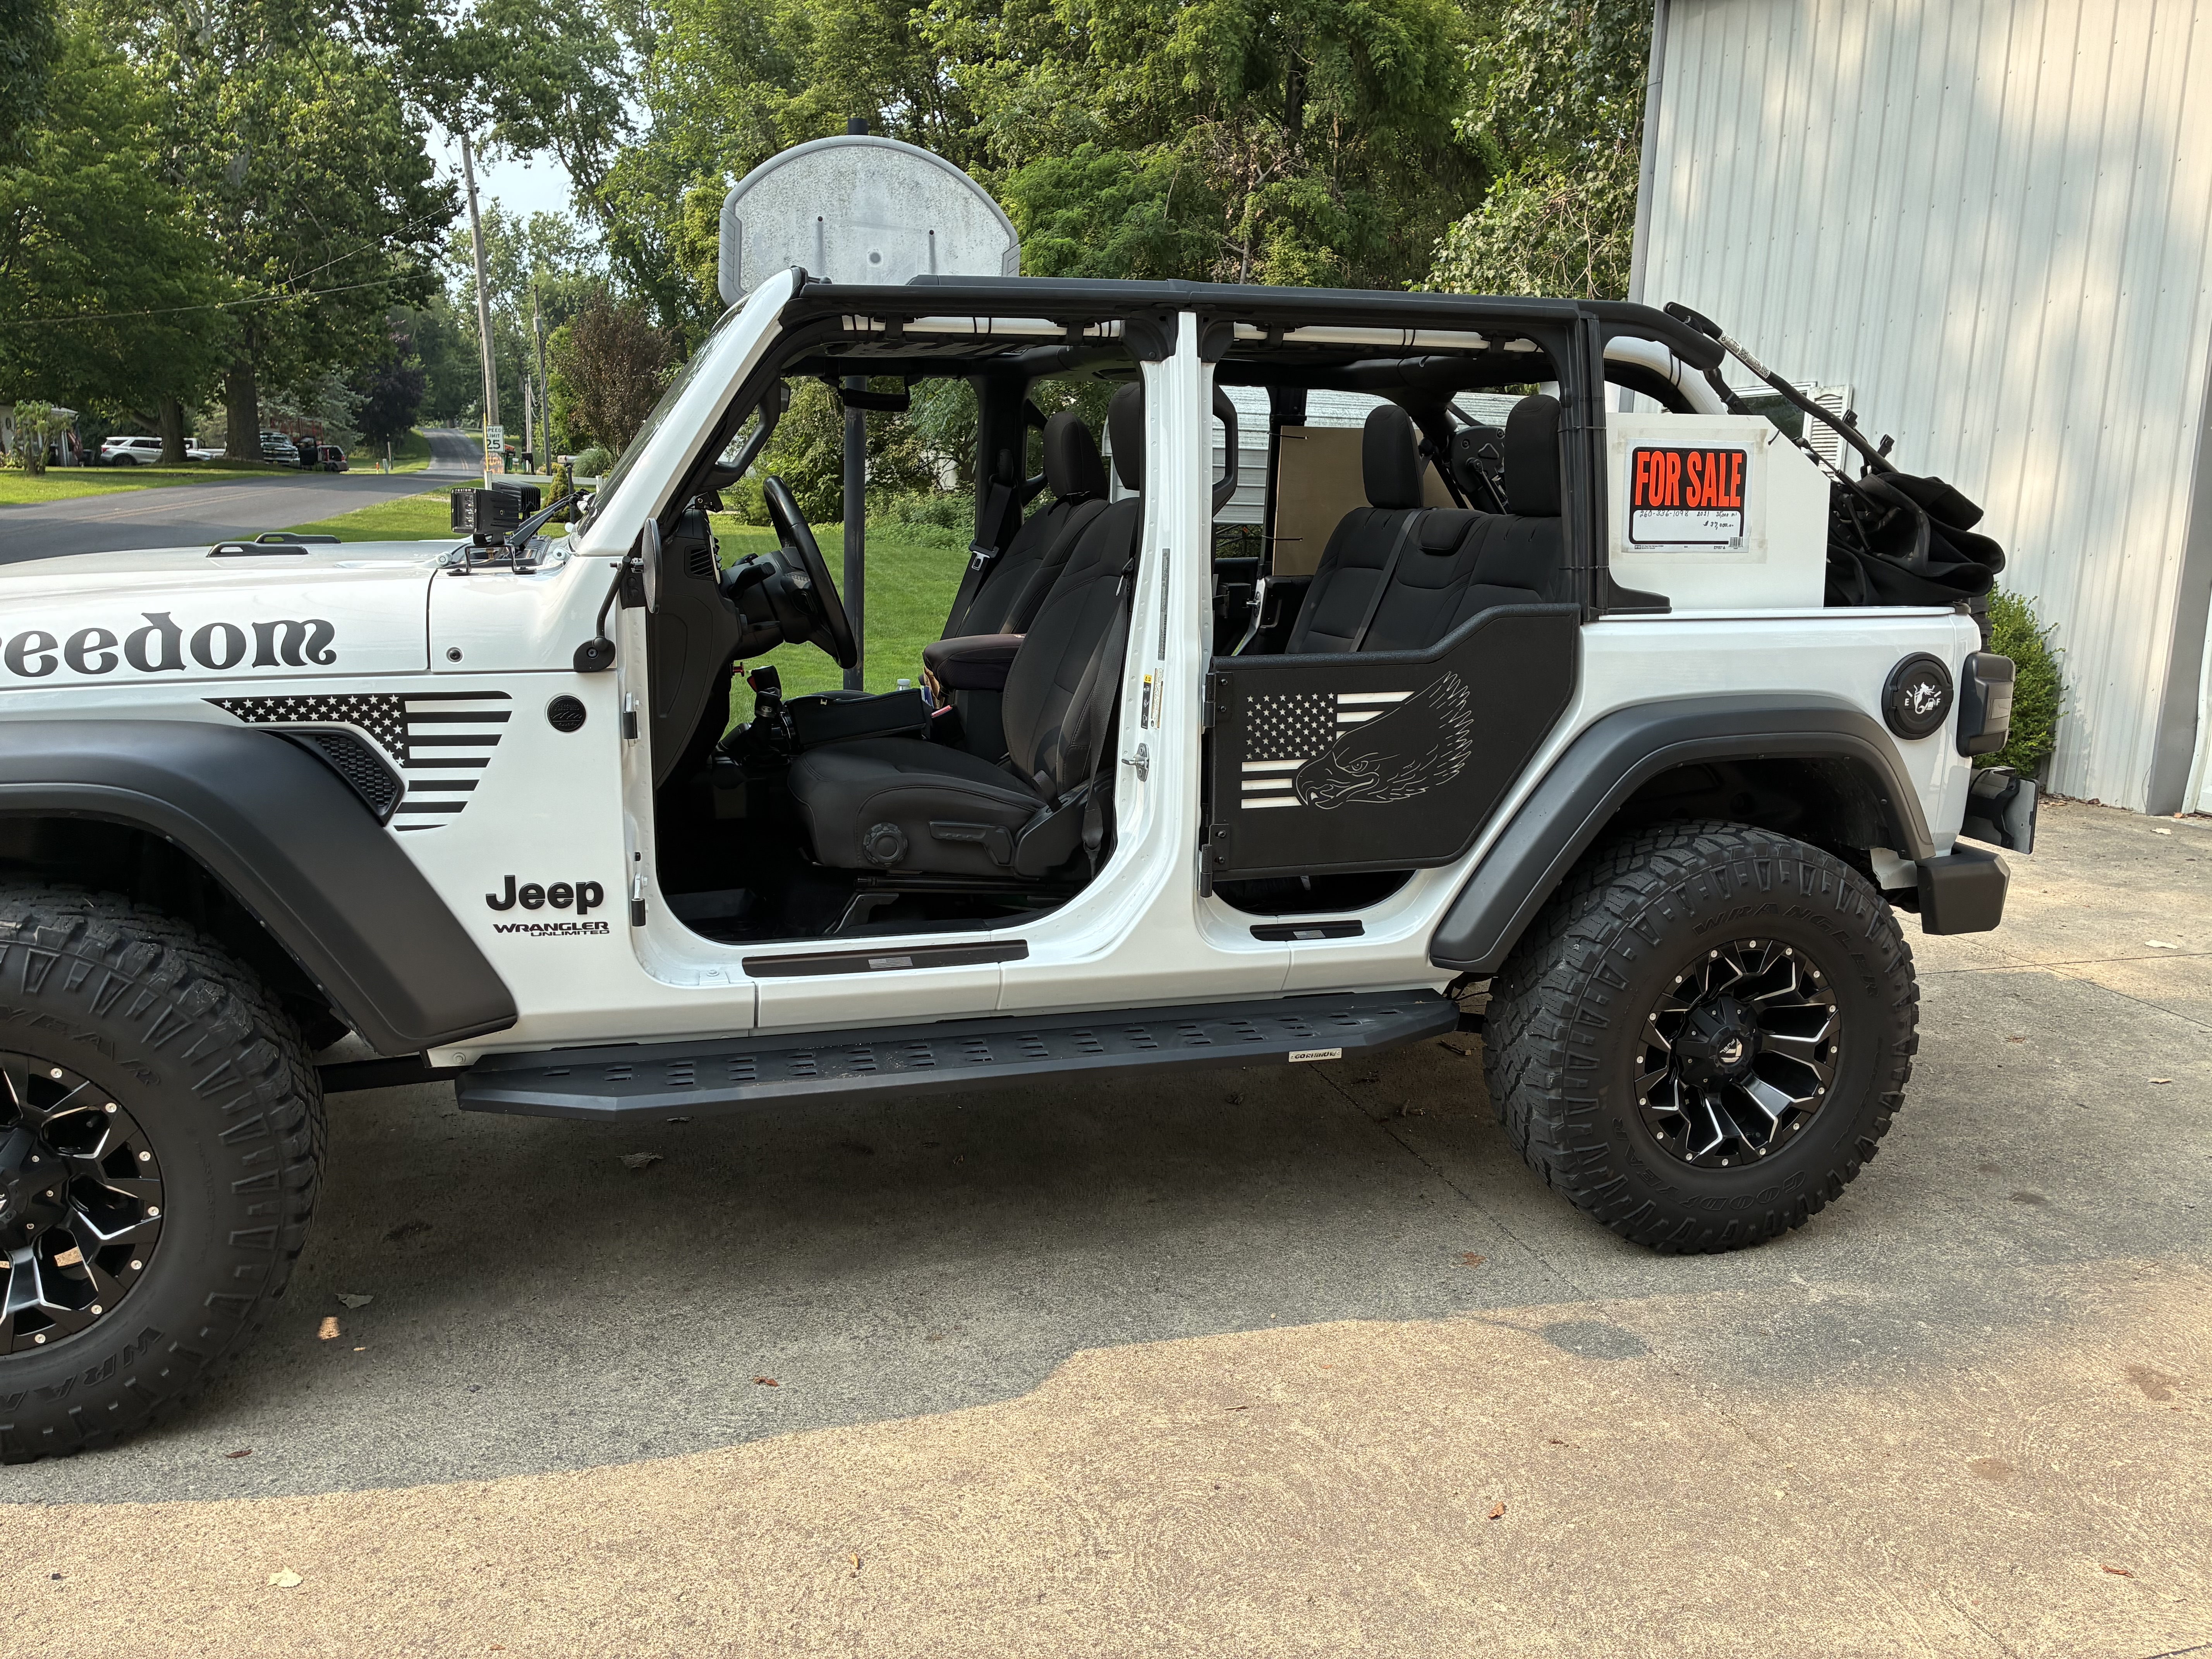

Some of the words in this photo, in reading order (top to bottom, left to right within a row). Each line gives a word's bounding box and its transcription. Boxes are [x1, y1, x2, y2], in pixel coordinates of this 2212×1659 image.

[487, 439, 500, 449] 25
[1635, 451, 1681, 507] FOR
[1686, 451, 1742, 507] SALE
[0, 611, 337, 677] eedom
[486, 874, 604, 915] Jeep
[493, 921, 610, 933] WRANGLER
[1692, 902, 1880, 998] WRANGLER
[1612, 1116, 1806, 1211] GOODYEAR
